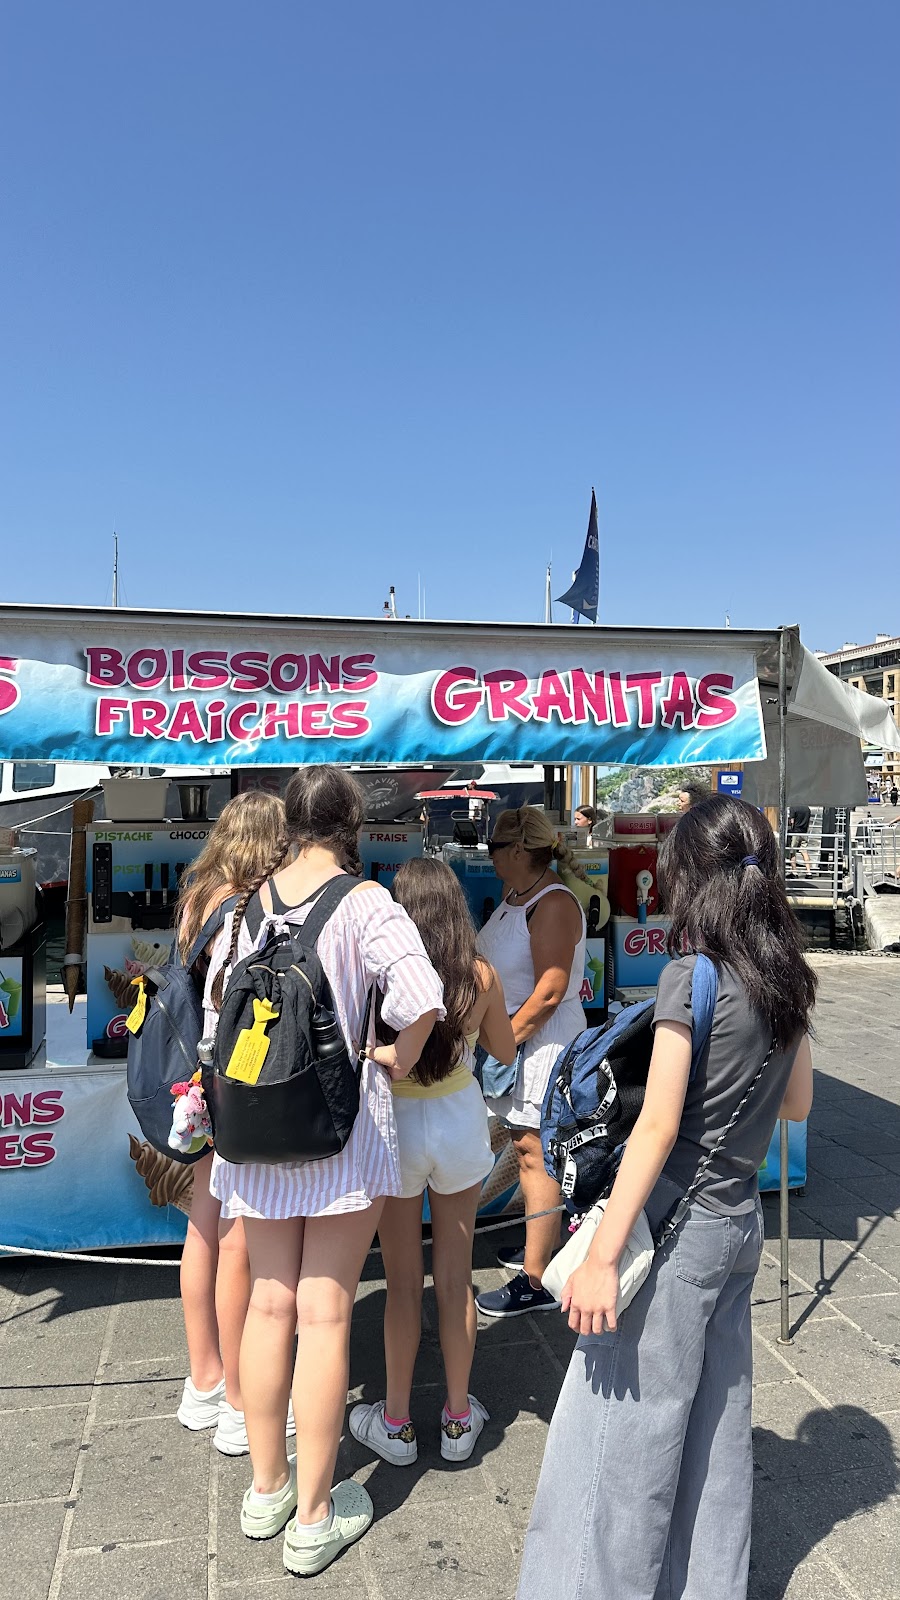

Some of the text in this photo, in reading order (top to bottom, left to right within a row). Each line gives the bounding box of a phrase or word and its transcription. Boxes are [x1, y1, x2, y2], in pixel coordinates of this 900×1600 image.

[86, 646, 378, 693] BOISSONS
[432, 667, 739, 729] GRANITAS
[366, 777, 399, 789] NAVIRE
[94, 832, 153, 841] PISTACHE
[369, 833, 408, 842] FRAISE
[0, 870, 17, 878] ANAS
